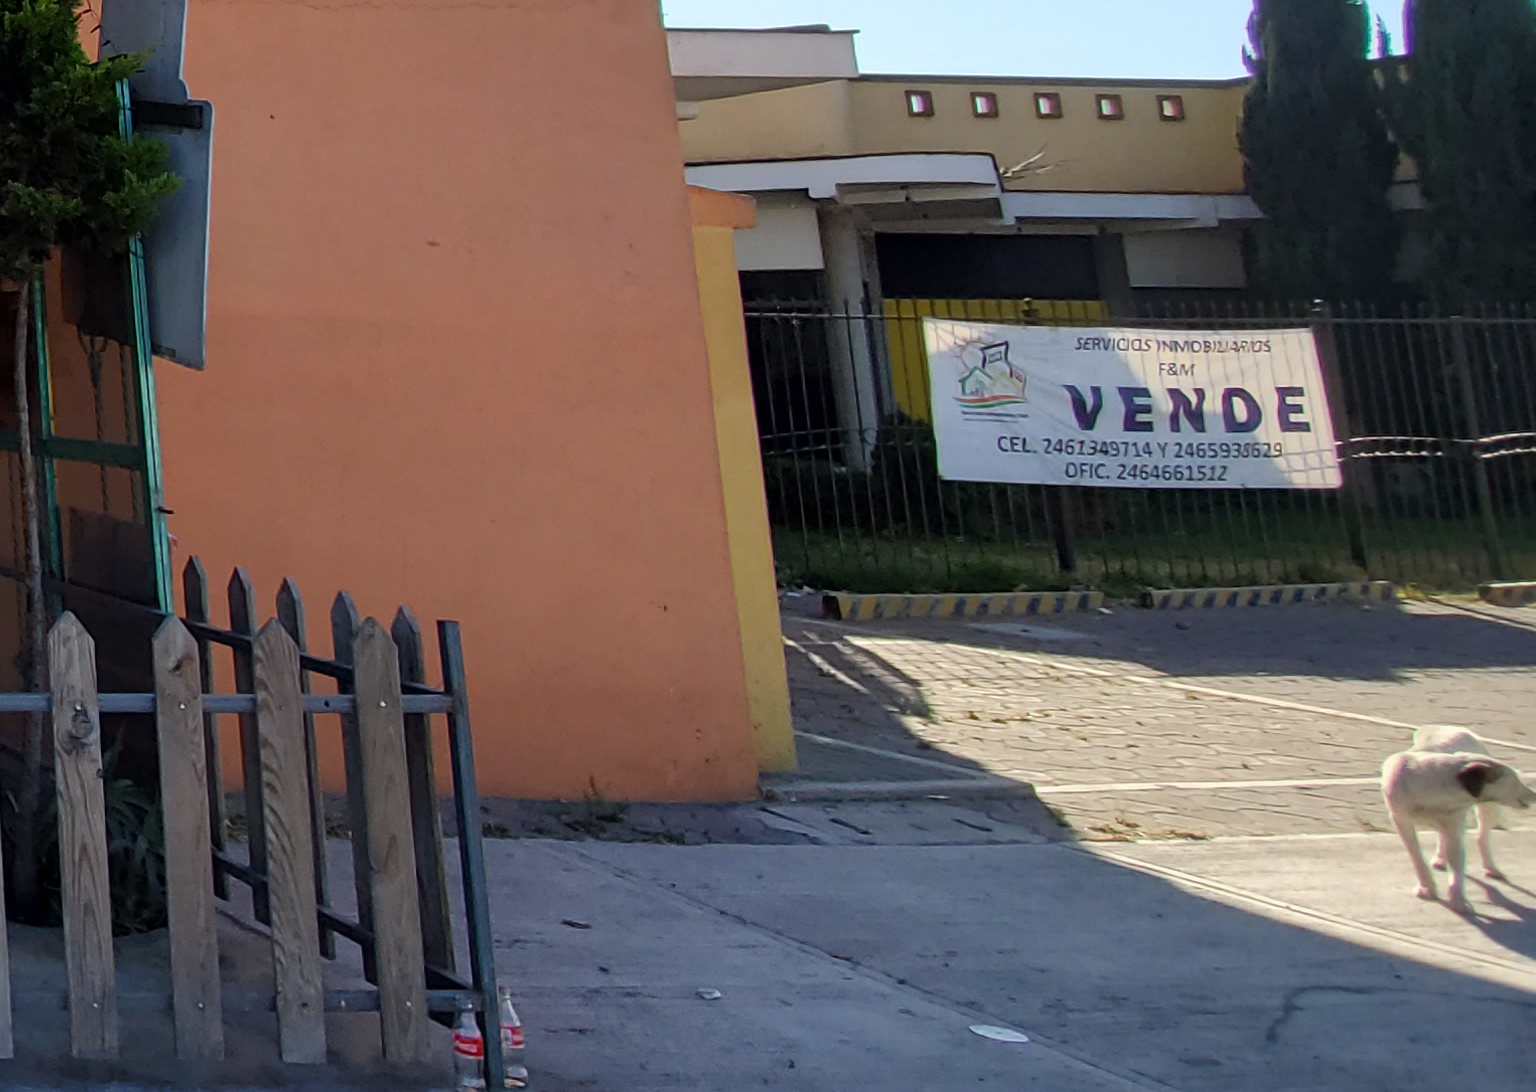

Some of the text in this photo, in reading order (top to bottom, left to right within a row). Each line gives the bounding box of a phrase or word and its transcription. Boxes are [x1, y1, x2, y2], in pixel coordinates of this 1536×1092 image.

[1075, 336, 1272, 354] SERVICIOS INMOBILIARIOS
[1159, 362, 1196, 377] F&M
[1063, 384, 1313, 434] VENDE
[997, 436, 1283, 459] CEL. 2461349714 Y 2465938629
[1064, 462, 1228, 481] OFIC. 2464661512
